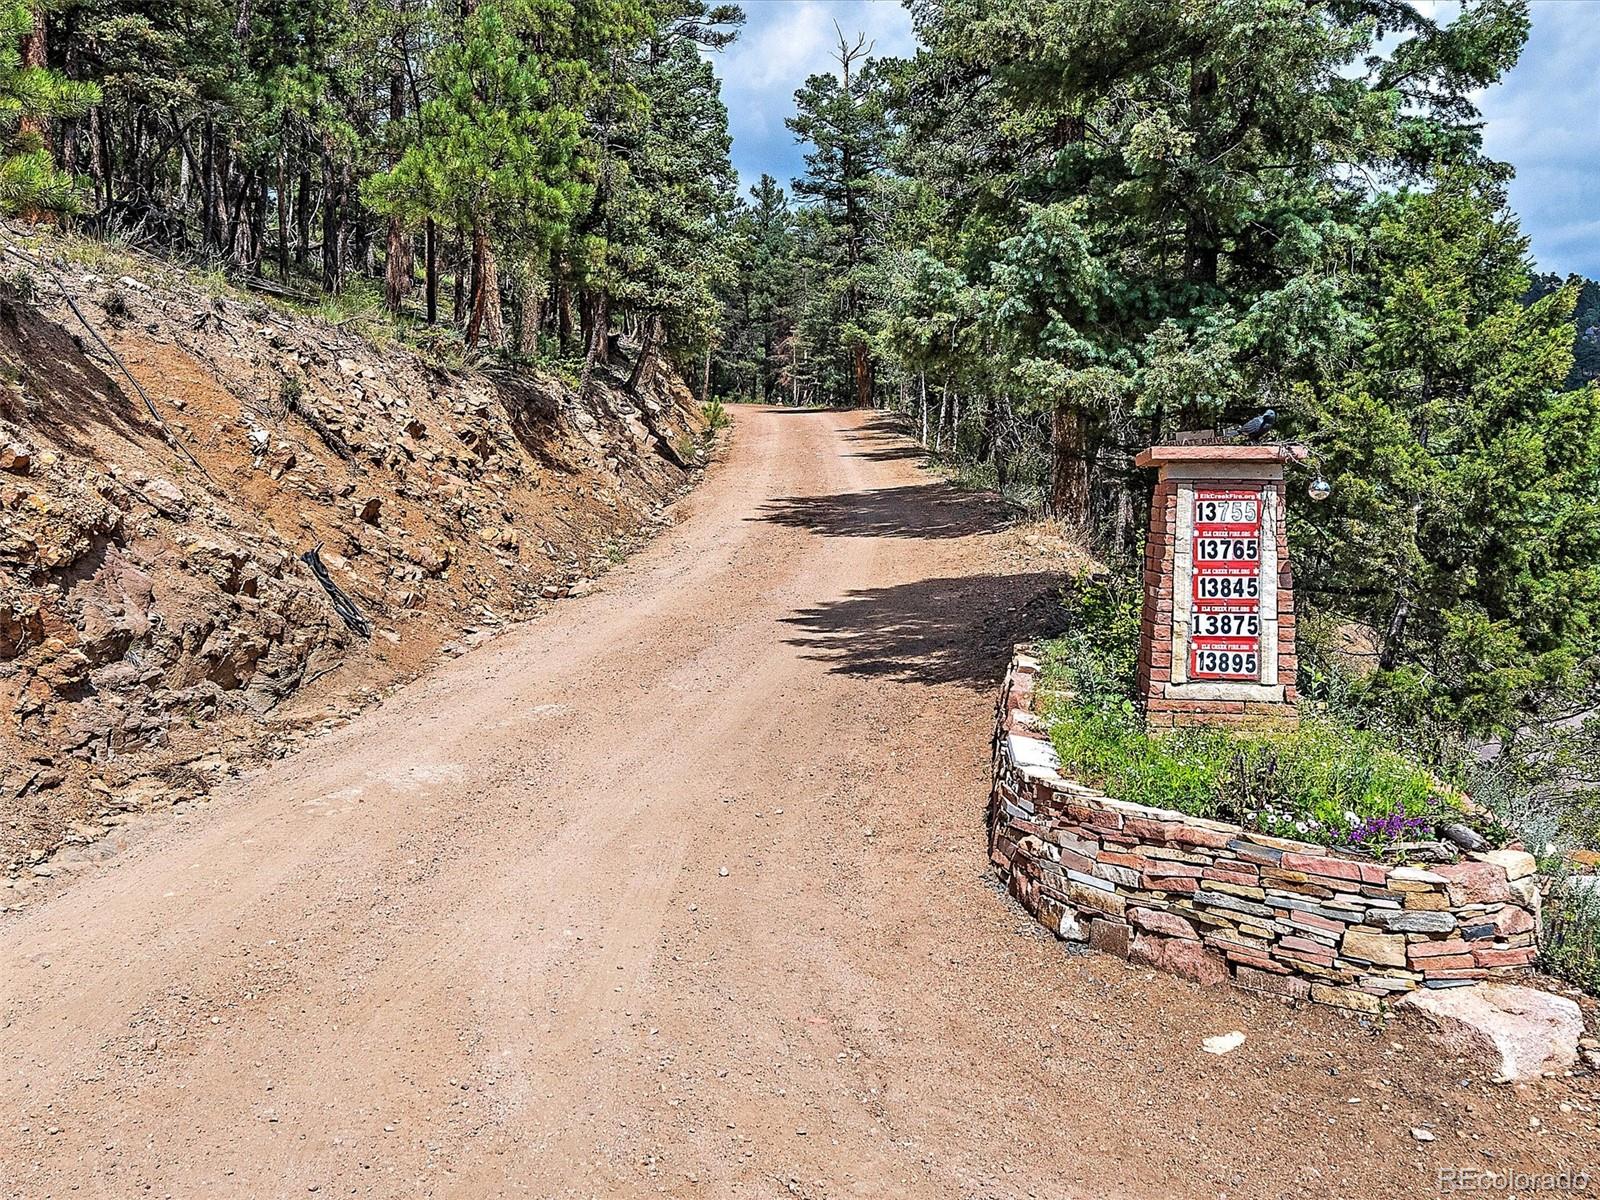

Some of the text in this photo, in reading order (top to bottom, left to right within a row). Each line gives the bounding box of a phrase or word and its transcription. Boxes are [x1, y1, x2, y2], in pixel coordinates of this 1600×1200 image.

[1201, 436, 1227, 446] DRIVE
[1197, 502, 1256, 521] 13755
[1199, 540, 1257, 559] 13765
[1199, 577, 1258, 597] 13845
[1193, 615, 1258, 635] 13875
[1198, 651, 1256, 673] 13895
